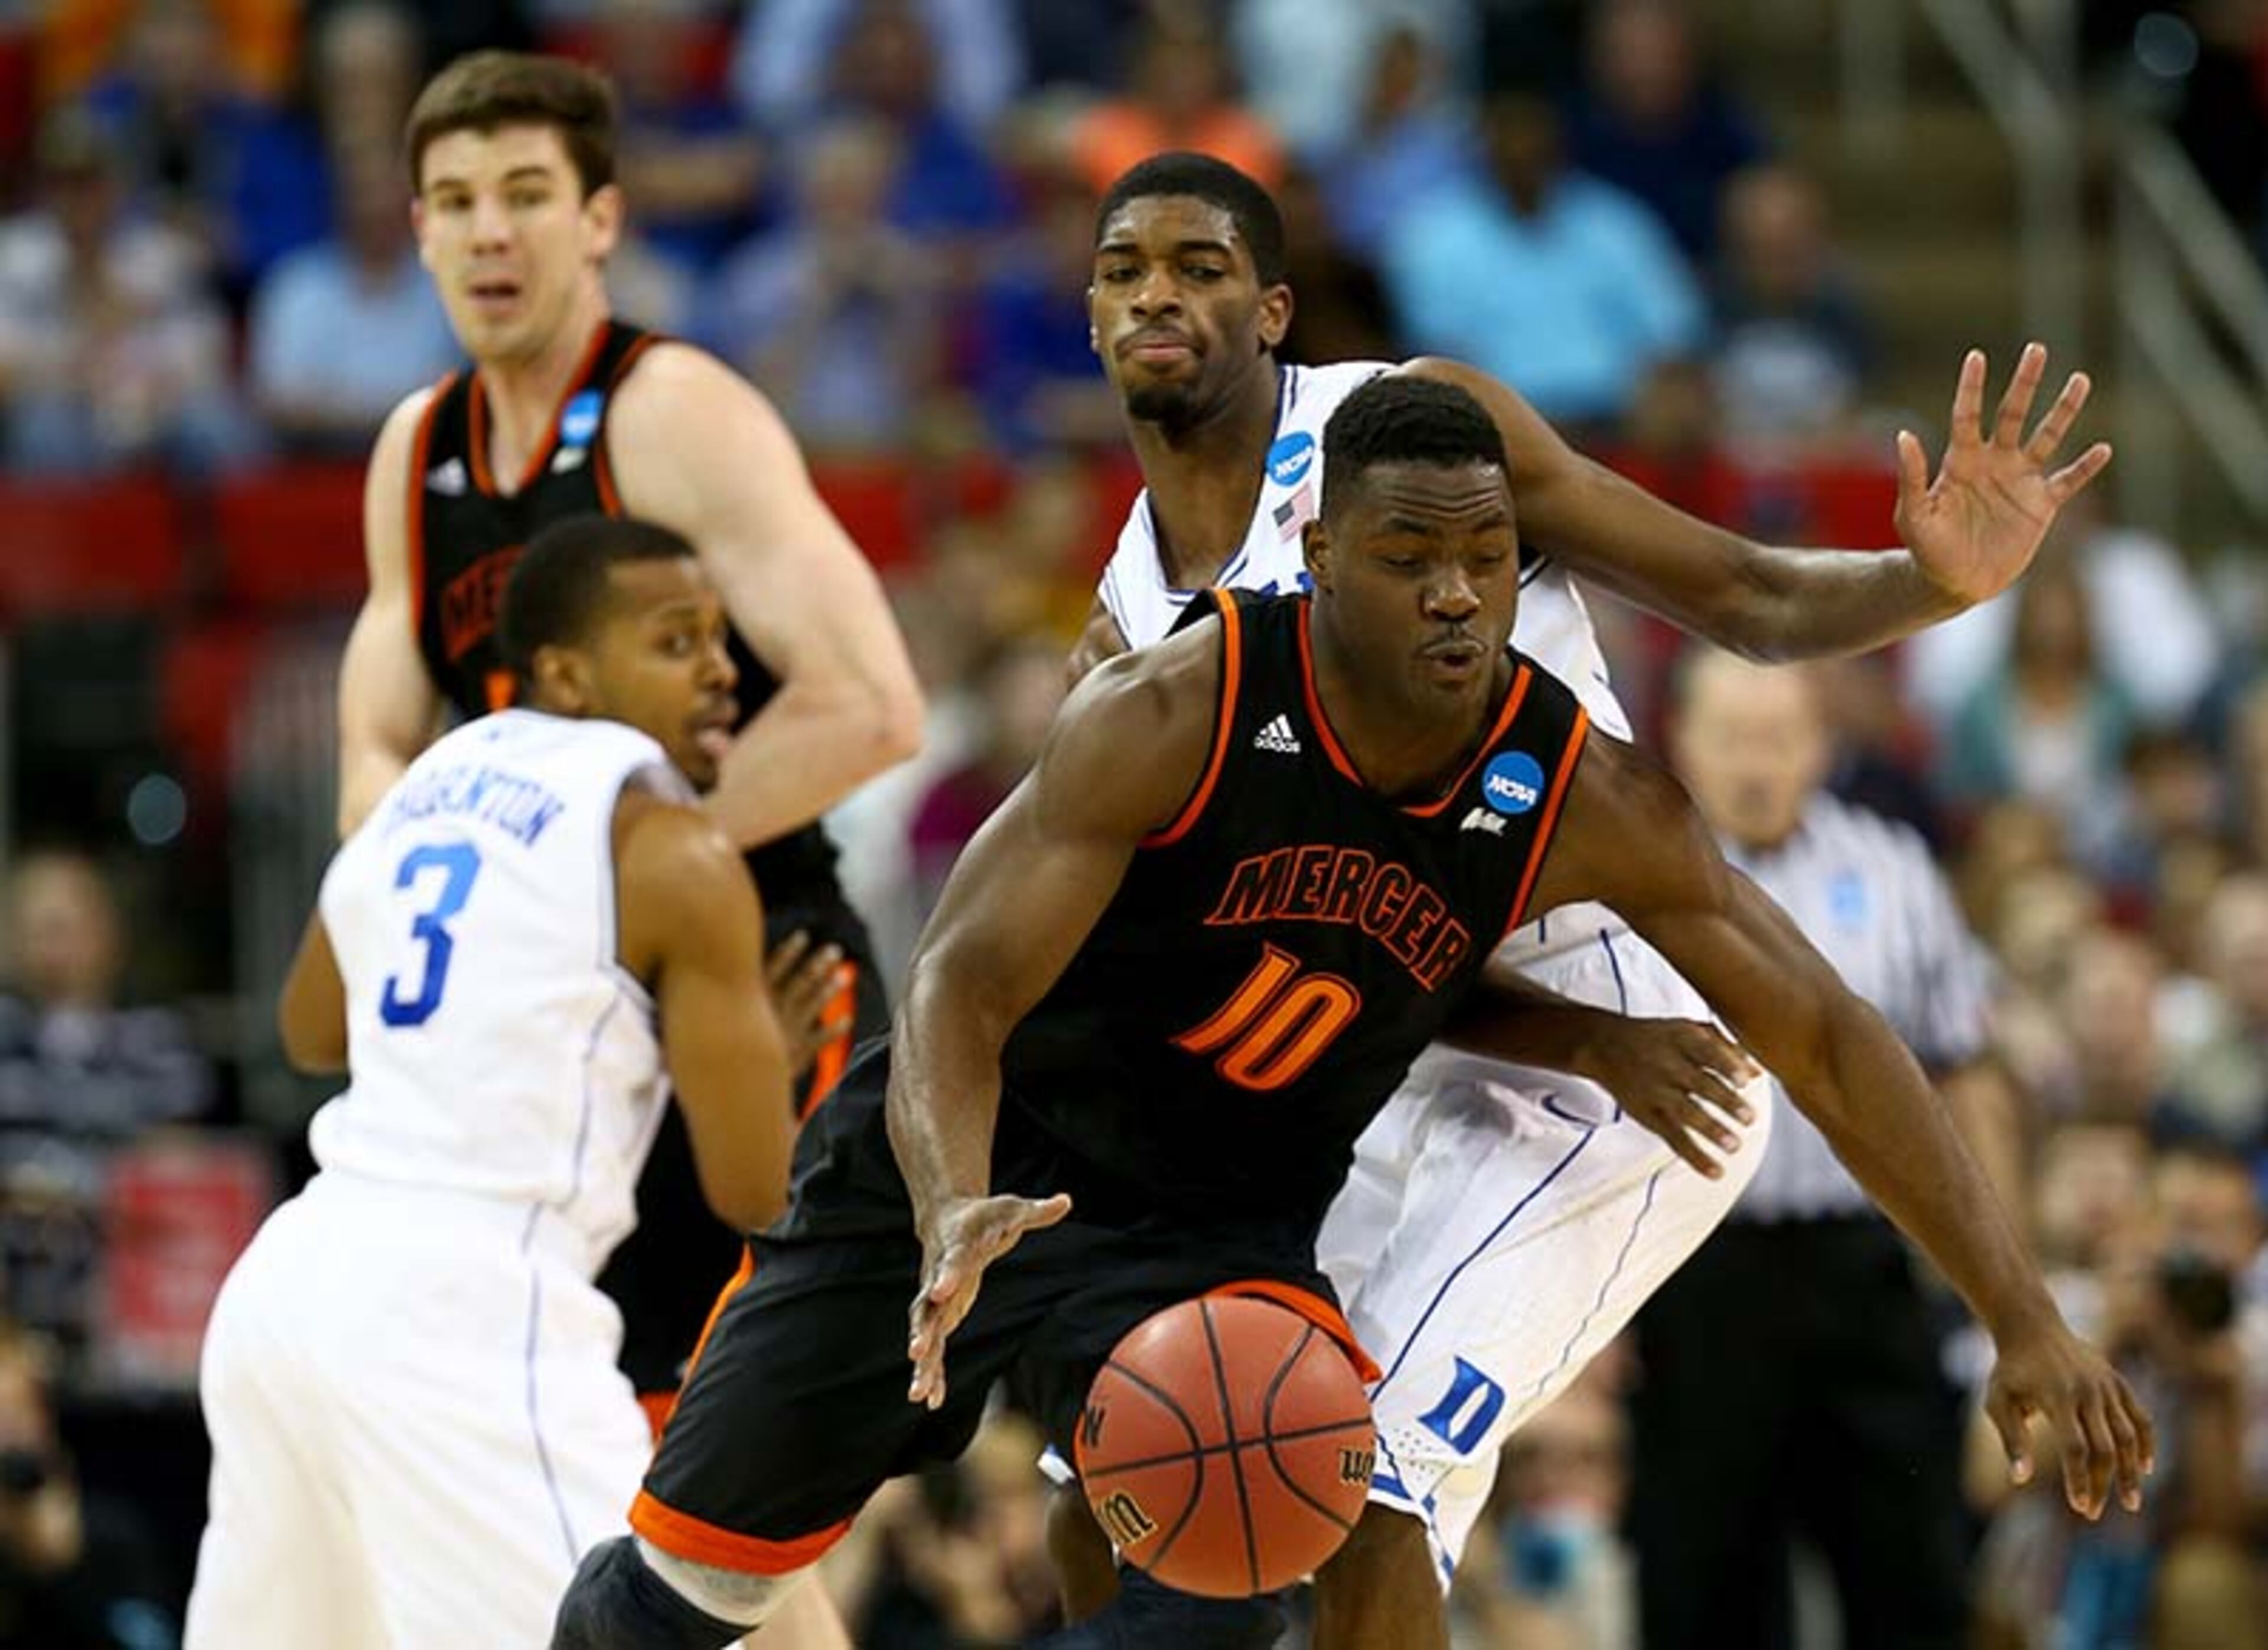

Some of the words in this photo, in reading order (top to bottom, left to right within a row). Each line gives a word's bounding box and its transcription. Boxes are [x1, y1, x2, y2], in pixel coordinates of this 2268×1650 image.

[1486, 773, 1538, 807] NCAA
[378, 843, 483, 1029] 3
[1203, 843, 1472, 993] MERCER
[1167, 940, 1363, 1091] 10
